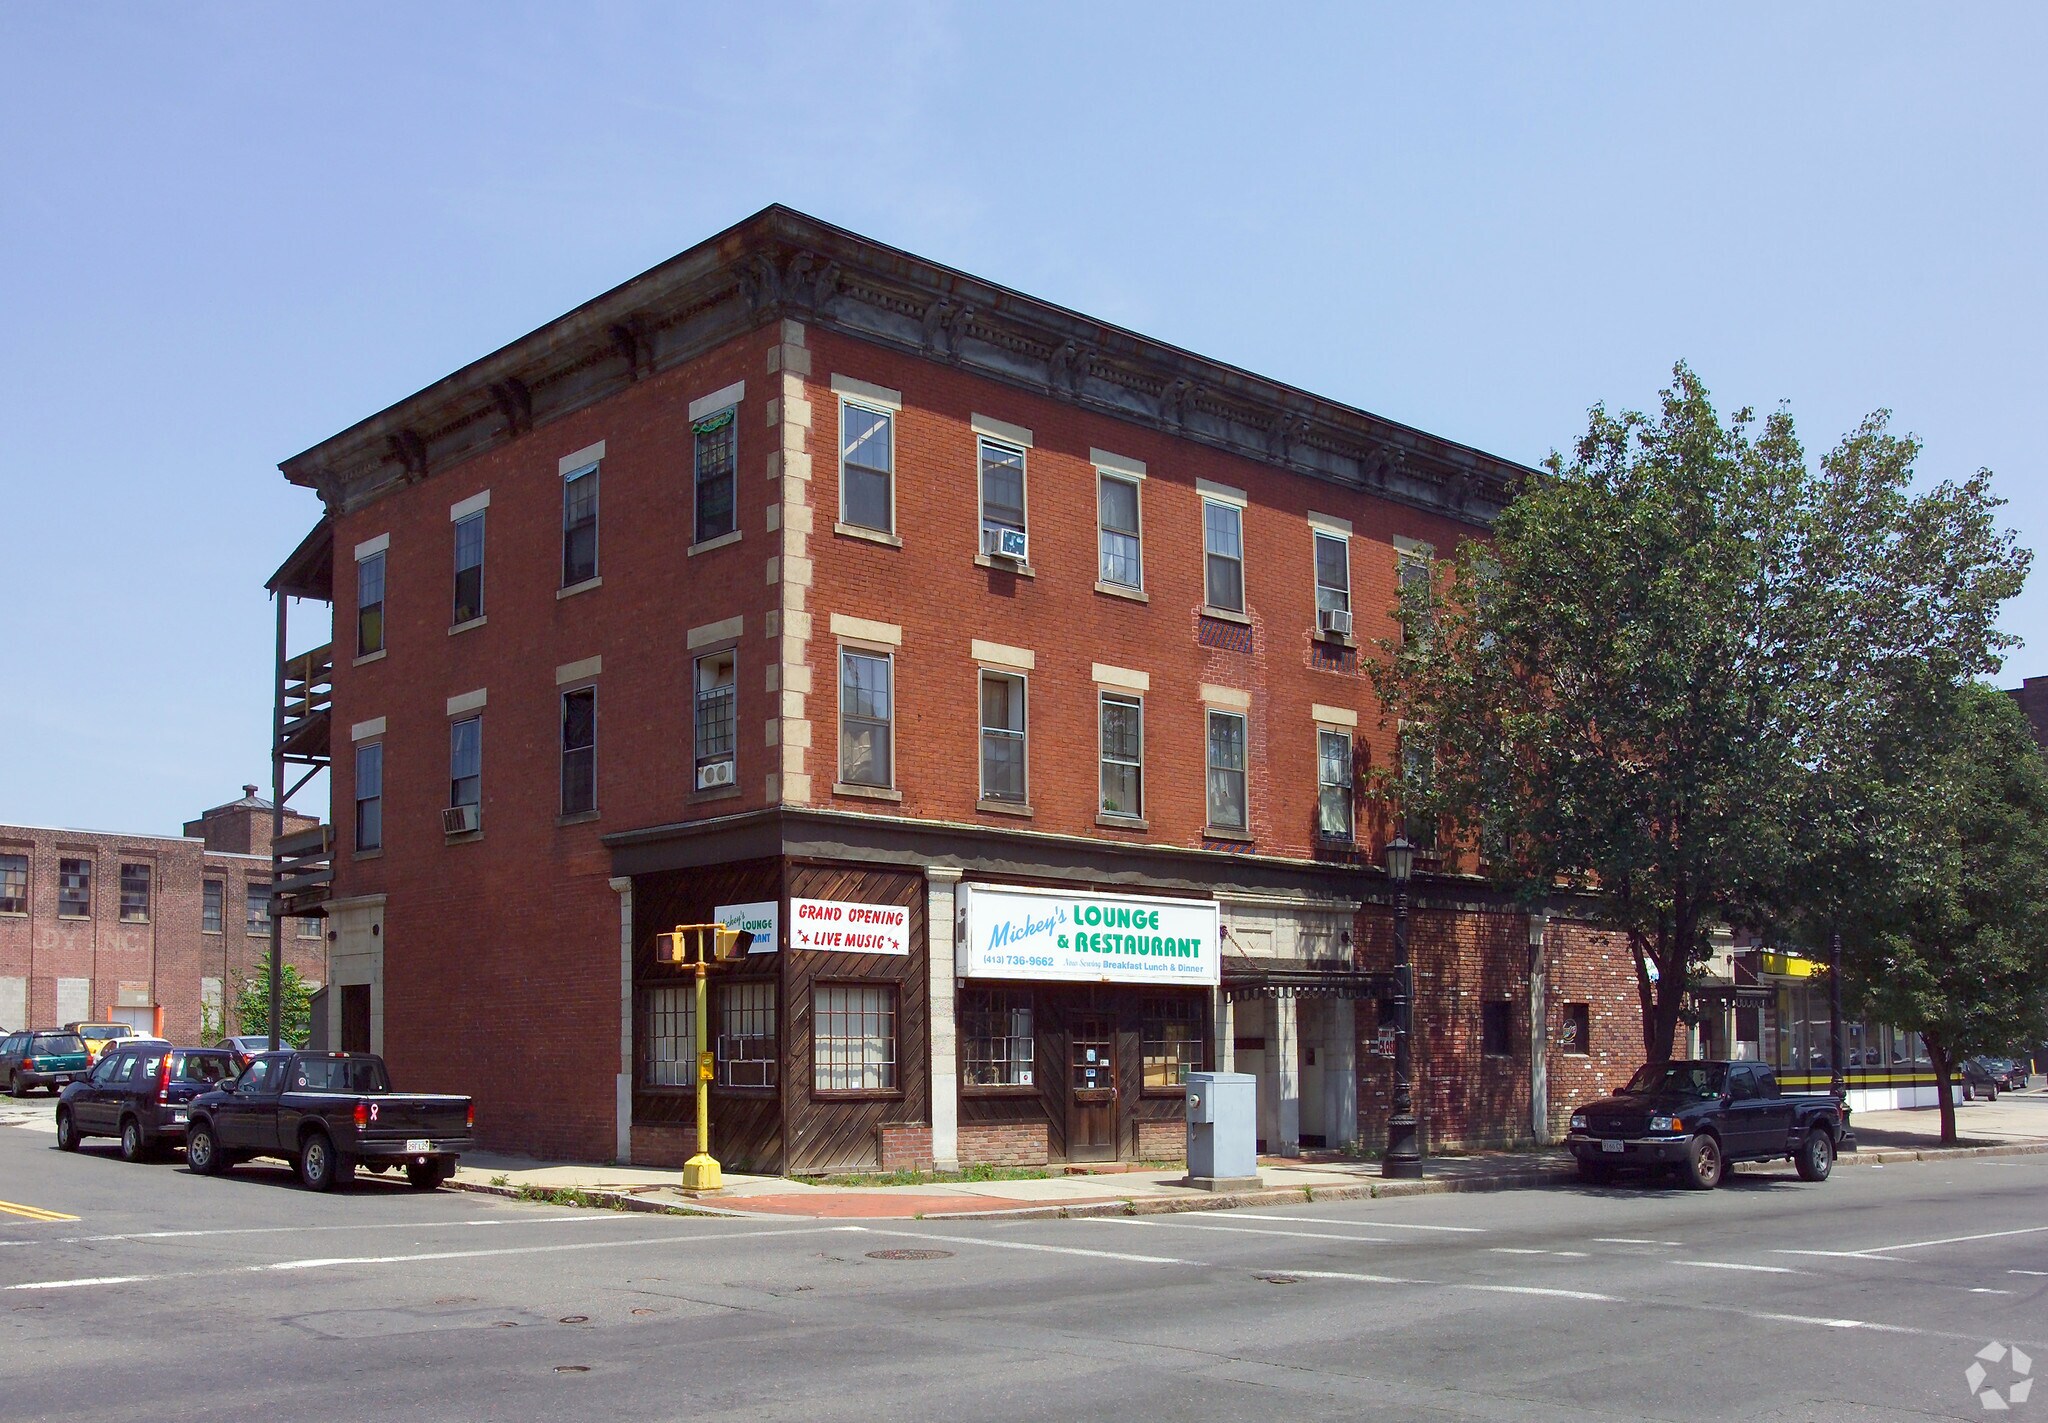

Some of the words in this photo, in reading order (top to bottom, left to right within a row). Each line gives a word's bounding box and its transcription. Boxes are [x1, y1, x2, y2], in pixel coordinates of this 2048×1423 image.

[799, 904, 842, 921] GRAND
[848, 908, 904, 926] OPENING
[742, 919, 772, 931] LOUNGE
[987, 906, 1067, 951] Mickey's
[1073, 905, 1159, 930] LOUNGE
[813, 932, 842, 947] LIVE
[844, 933, 885, 949] MUSIC
[1057, 934, 1070, 949] &
[1075, 931, 1201, 958] RESTAURANT
[983, 955, 1004, 965] (413)
[1006, 955, 1054, 966] 736-9662
[1103, 960, 1142, 970] Breakfast
[1144, 962, 1168, 971] Lunch
[1178, 963, 1203, 973] Dinner
